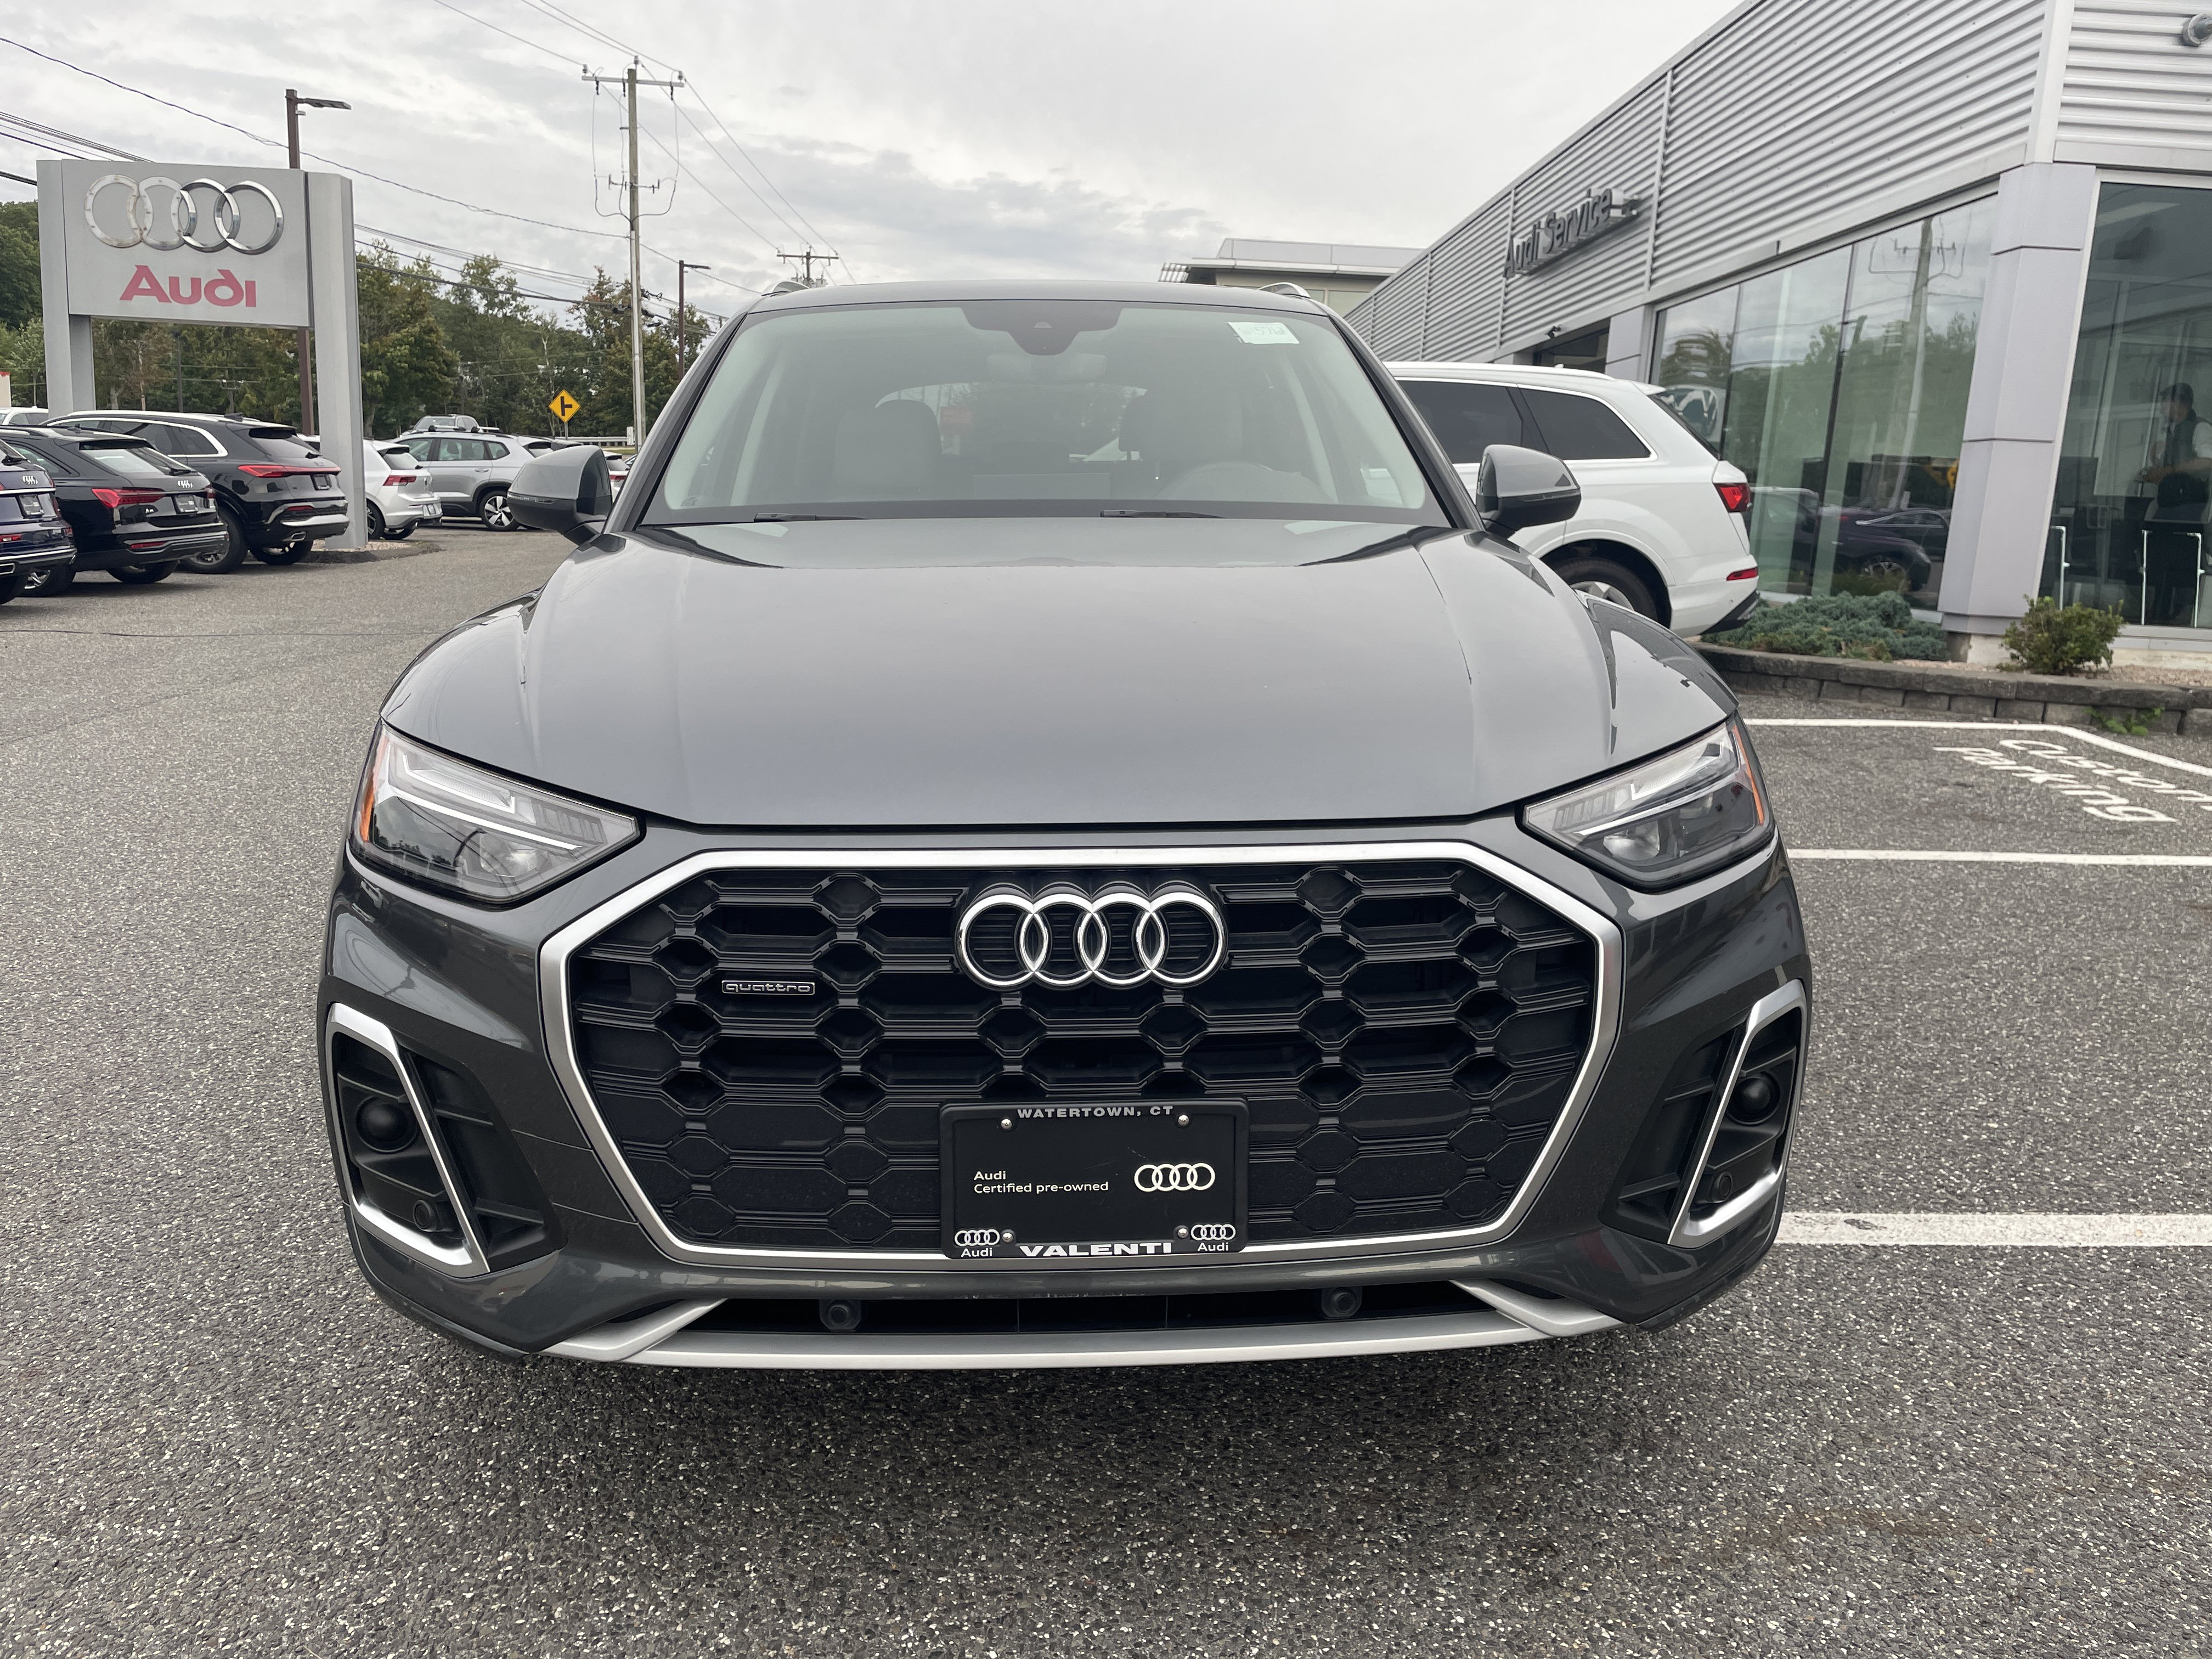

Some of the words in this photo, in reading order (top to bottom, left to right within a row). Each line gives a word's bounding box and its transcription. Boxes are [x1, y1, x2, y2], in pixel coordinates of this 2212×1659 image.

[1504, 221, 1541, 278] Audi
[1545, 188, 1613, 254] Service
[119, 264, 257, 308] Audi
[1932, 746, 2179, 822] Parking
[725, 983, 810, 992] quattro
[1017, 1106, 1141, 1119] WATERTOWN,
[1149, 1105, 1174, 1116] CT
[973, 1170, 1007, 1181] Audi
[973, 1182, 1032, 1194] Certified
[1036, 1181, 1109, 1194] pre-owned
[961, 1247, 993, 1257] Audi
[1019, 1242, 1172, 1257] VALENTI
[1197, 1241, 1229, 1252] Audi
